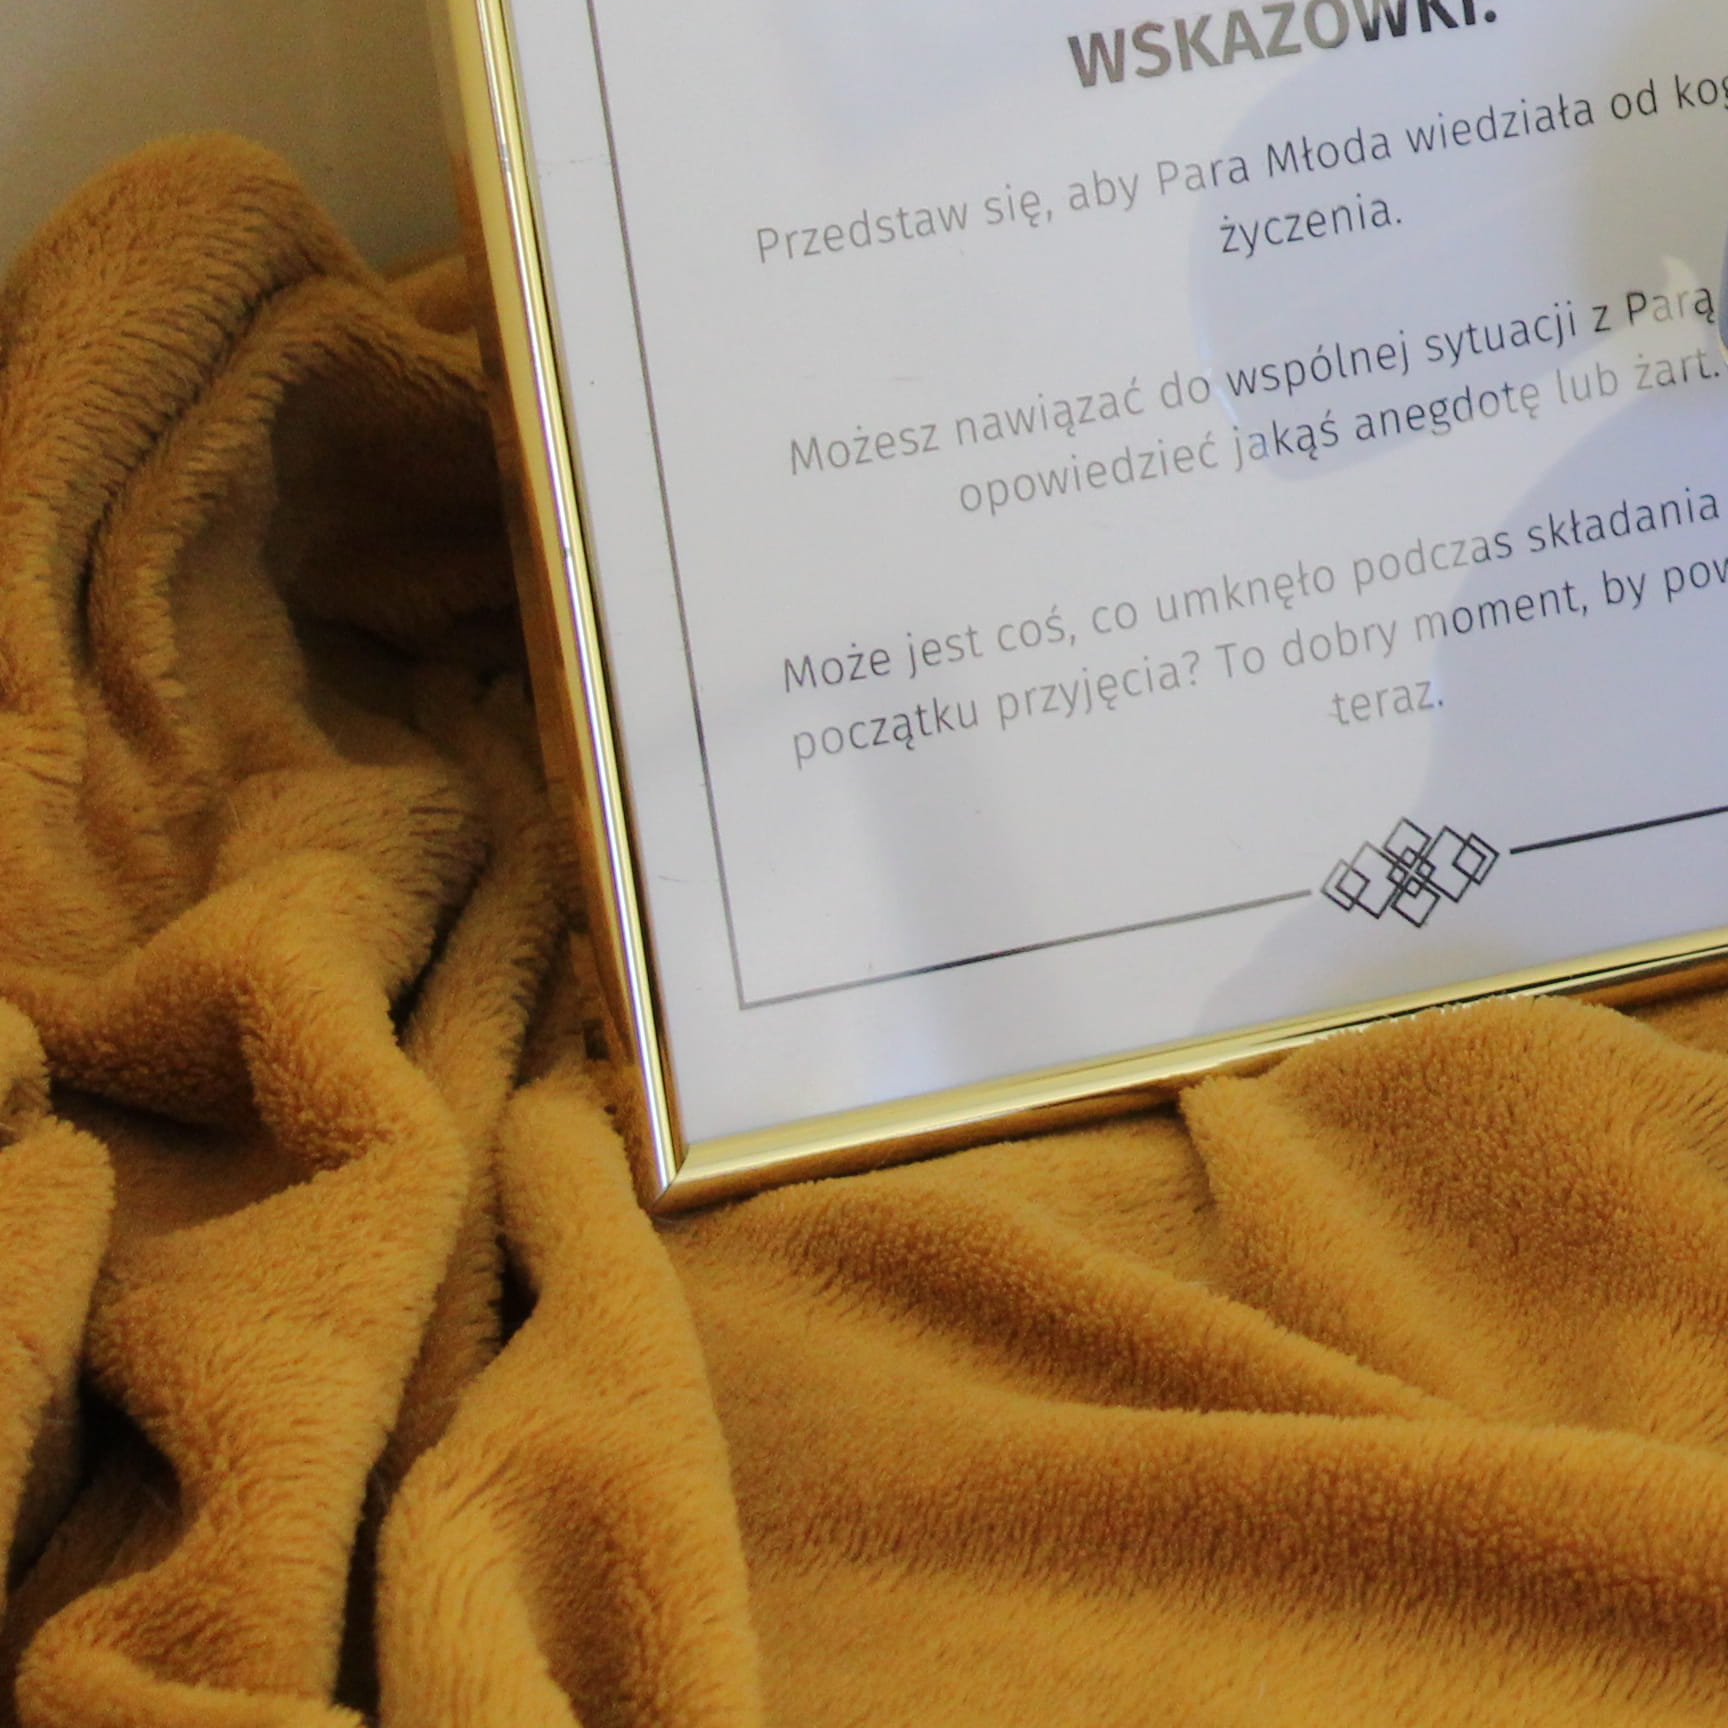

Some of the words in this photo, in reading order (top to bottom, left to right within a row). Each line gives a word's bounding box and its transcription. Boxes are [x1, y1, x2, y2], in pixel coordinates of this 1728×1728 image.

[756, 203, 967, 264] Przedstaw
[984, 183, 1052, 229] się,
[1069, 170, 1139, 212] aby
[1156, 156, 1250, 196] Para
[1267, 126, 1392, 178] Młoda
[1405, 93, 1595, 154] wiedziała
[1610, 78, 1658, 121] od
[1218, 200, 1404, 260] życzenia.
[790, 424, 940, 476] Możesz
[955, 376, 1144, 446] nawiązać
[1160, 370, 1211, 409] do
[1225, 329, 1409, 397] wspólnej
[1425, 300, 1576, 368] sytuacji
[1591, 304, 1612, 334] z
[1625, 287, 1714, 326] Parą
[960, 431, 1218, 517] opowiedzieć
[1232, 409, 1339, 472] jakąś
[1355, 381, 1539, 442] anegdotę
[1556, 363, 1618, 404] lub
[1635, 350, 1720, 390] żart.
[784, 642, 891, 693] Może
[906, 625, 983, 679] jest
[997, 604, 1076, 652] coś,
[1092, 602, 1137, 634] co
[1156, 560, 1335, 623] umknęło
[1353, 531, 1513, 596] podczas
[1527, 487, 1720, 553] składania
[793, 697, 978, 771] początku
[997, 650, 1200, 731] przyjęcia?
[1215, 642, 1265, 678] To
[1282, 620, 1397, 667] dobry
[1415, 580, 1588, 641] moment,
[1601, 569, 1646, 610] by
[1330, 681, 1444, 726] teraz.
